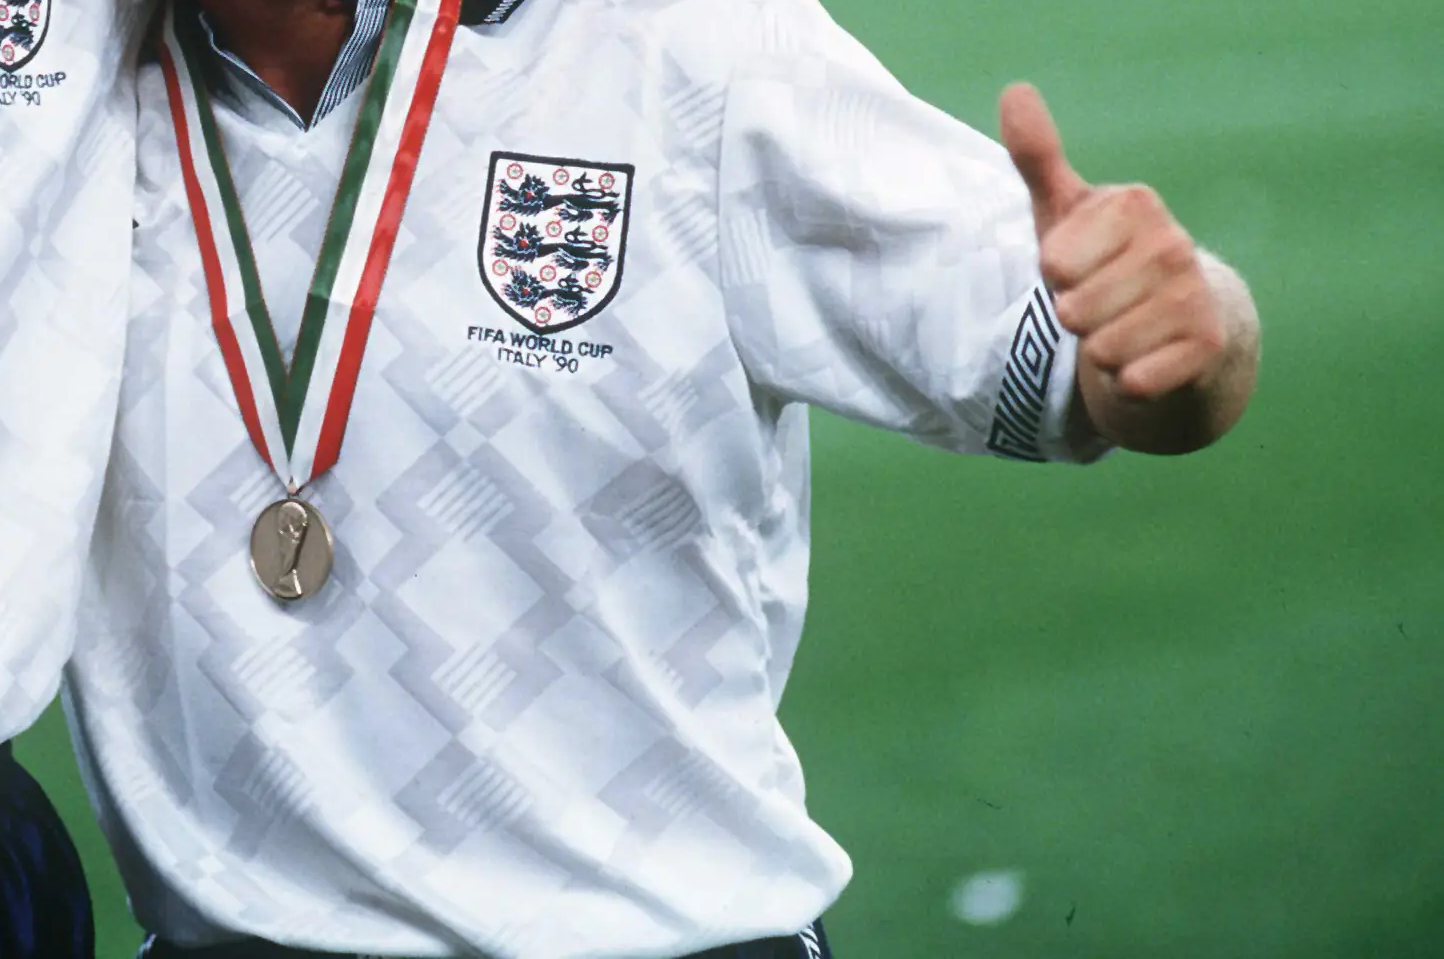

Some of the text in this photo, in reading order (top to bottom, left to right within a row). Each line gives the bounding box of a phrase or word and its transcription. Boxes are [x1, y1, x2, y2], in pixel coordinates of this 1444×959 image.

[36, 71, 67, 88] CUP
[467, 326, 613, 359] FIFA WORLD CUP
[497, 347, 547, 368] ITALY
